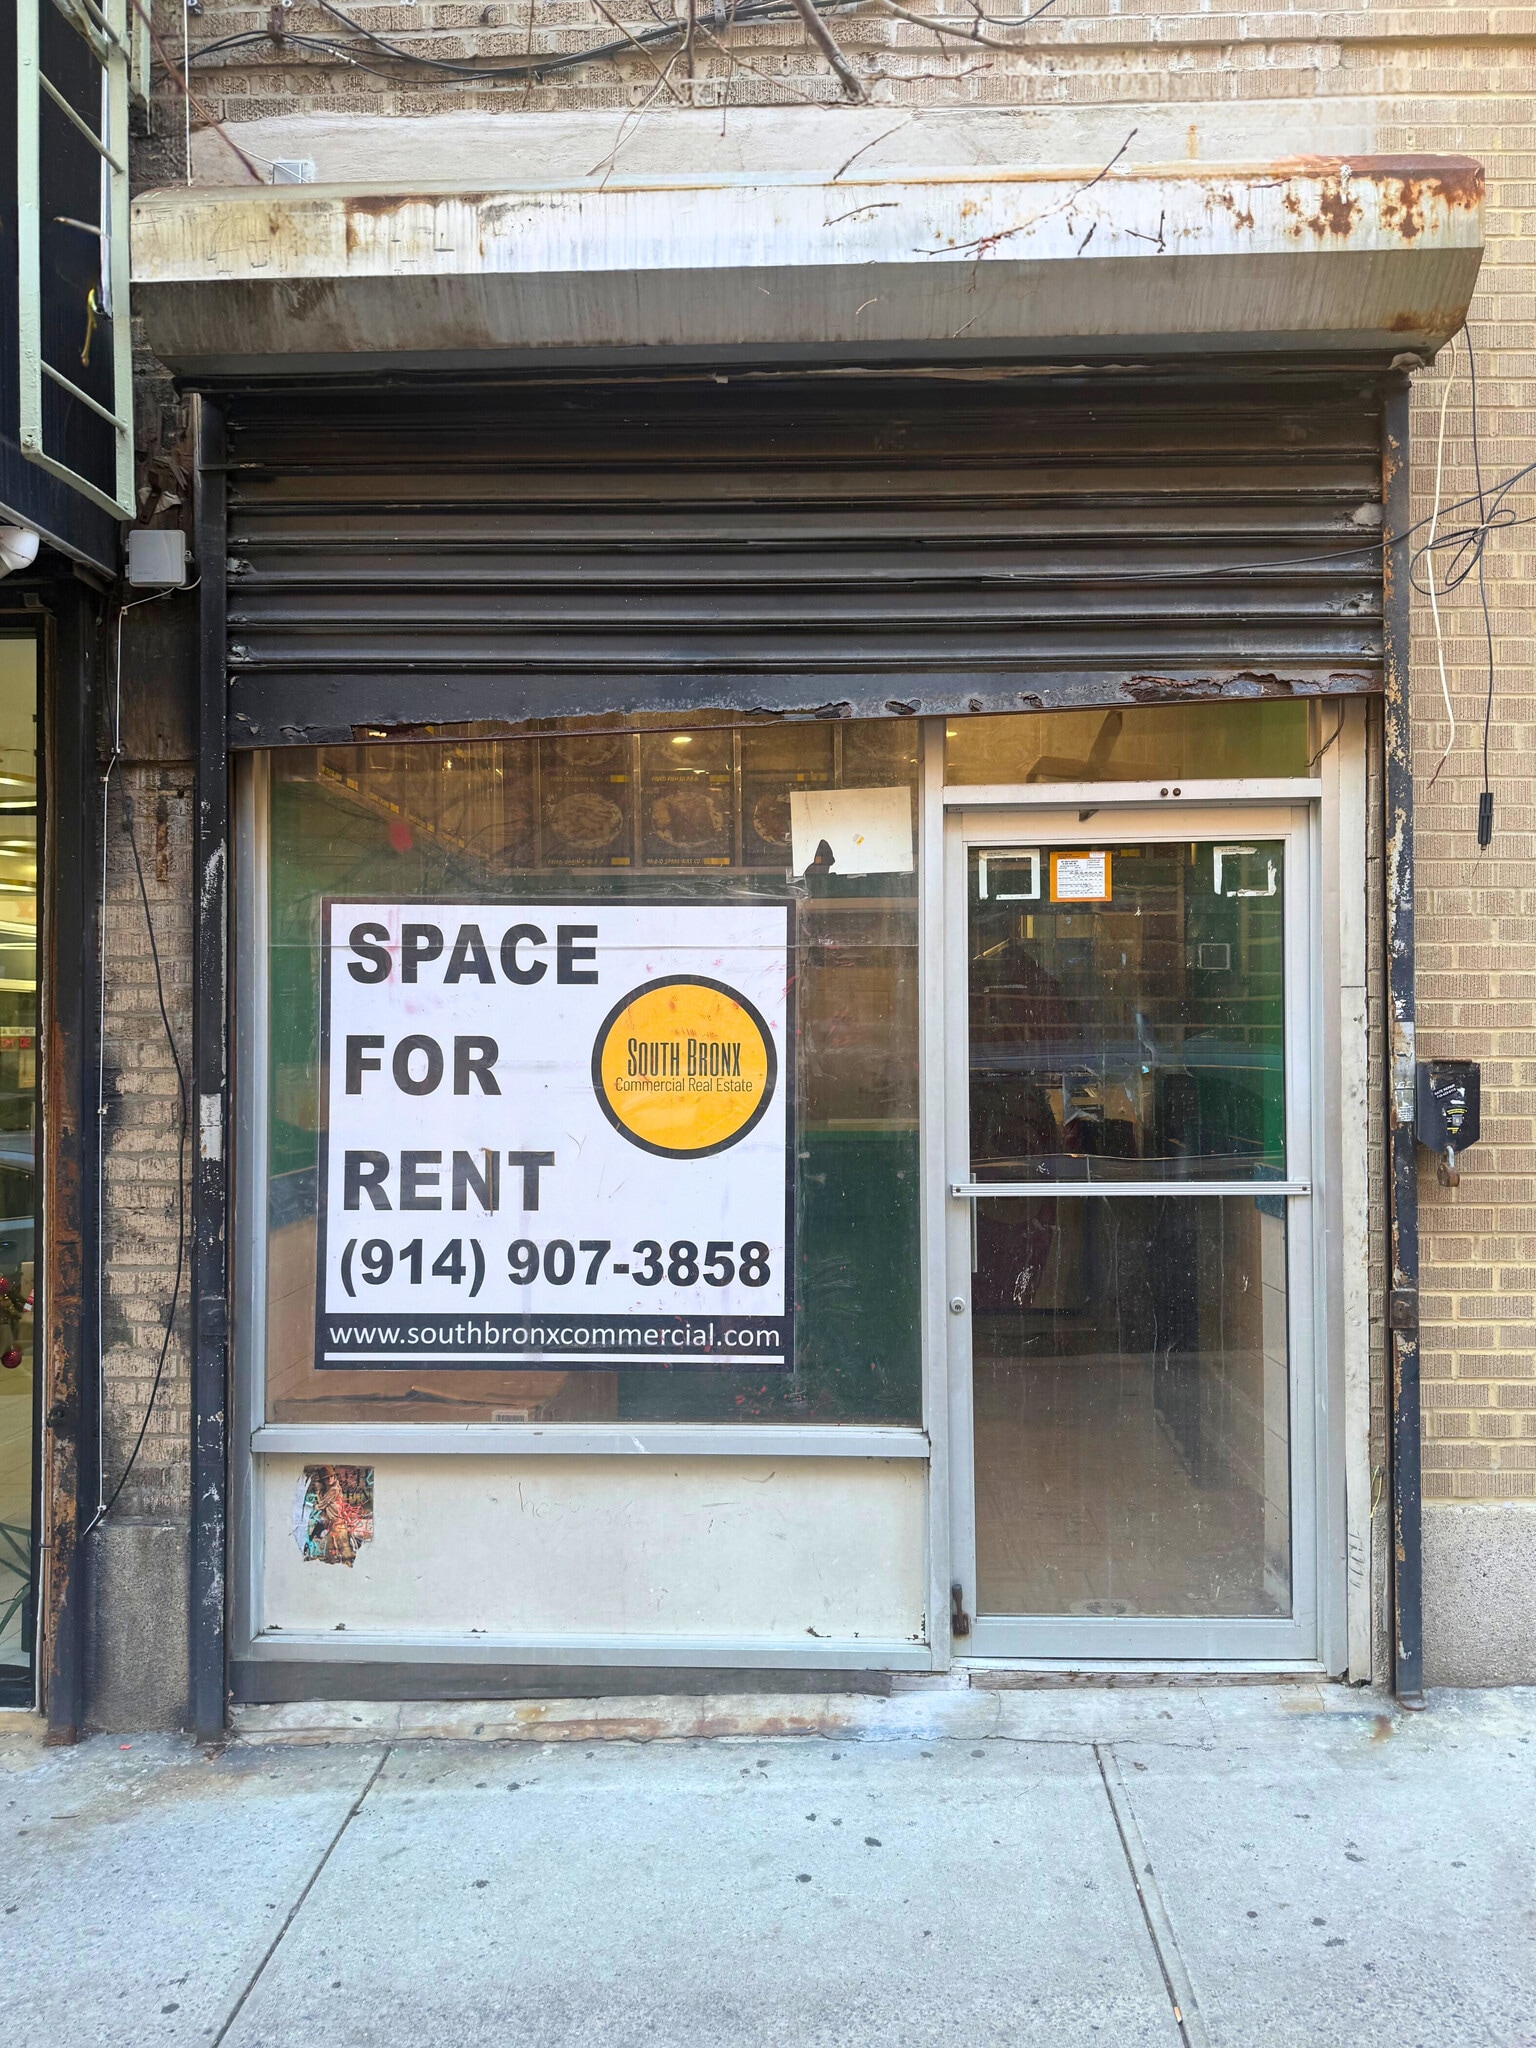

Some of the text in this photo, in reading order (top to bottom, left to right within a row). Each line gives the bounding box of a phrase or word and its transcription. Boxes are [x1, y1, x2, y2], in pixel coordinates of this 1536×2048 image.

[348, 923, 598, 985] SPACE
[346, 1035, 501, 1095] FOR
[616, 1077, 752, 1091] Commercial Real Estate
[344, 1150, 554, 1211] RENT
[341, 1239, 770, 1297] (914) 907-3858
[330, 1321, 779, 1347] www.southbronxcommercial.com
